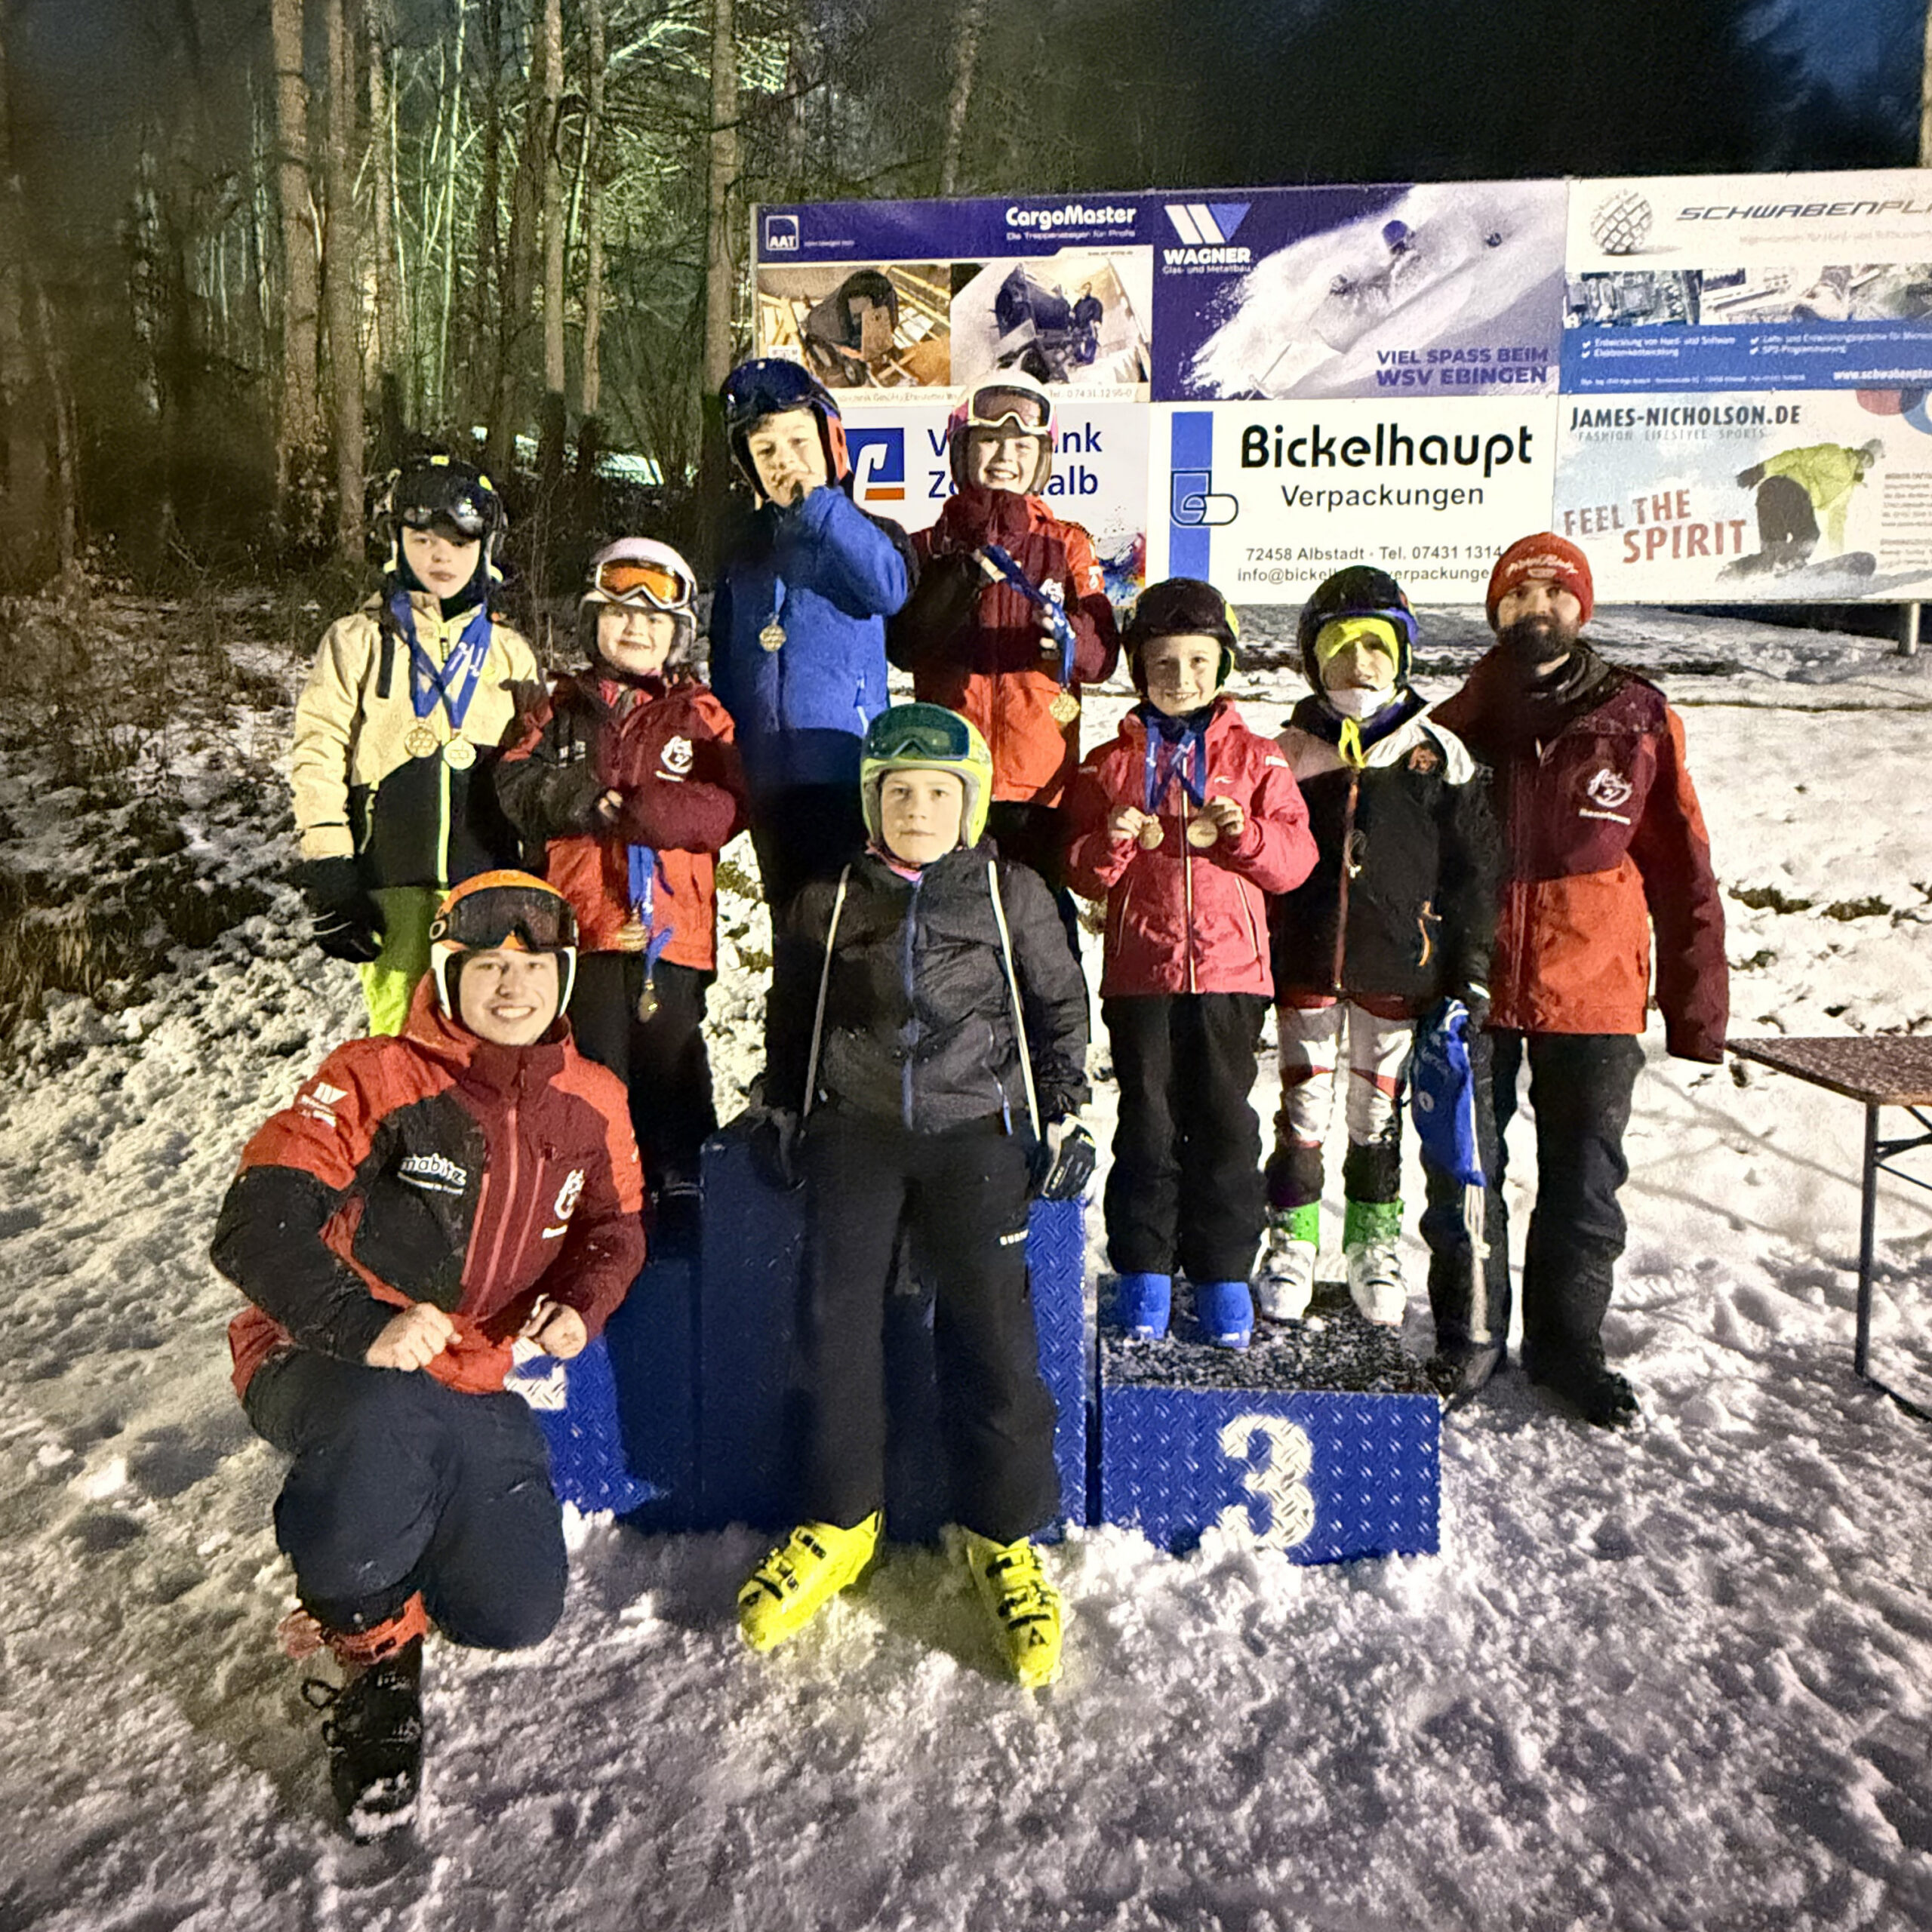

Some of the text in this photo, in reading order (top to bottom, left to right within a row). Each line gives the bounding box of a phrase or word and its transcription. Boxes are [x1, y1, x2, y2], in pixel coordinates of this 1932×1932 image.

[1005, 205, 1137, 231] CargoMaster
[769, 235, 796, 248] AAT
[1163, 247, 1251, 265] WAGNER
[1186, 264, 1205, 274] und
[1377, 347, 1548, 365] VIEL SPASS BEIM
[1376, 366, 1548, 386] WSV EBINGEN
[1570, 405, 1801, 431] JAMES-NICHOLSON.DE
[1241, 423, 1533, 478] Bickelhaupt
[1281, 484, 1484, 512] Verpackungen
[1564, 488, 1691, 536] FEEL THE
[1245, 548, 1293, 561] 72458
[1297, 546, 1364, 561] Albstadt
[1379, 546, 1407, 560] Tel.
[1411, 546, 1458, 559] 07431
[1622, 519, 1746, 564] SPIRIT
[1217, 1414, 1315, 1550] 3
